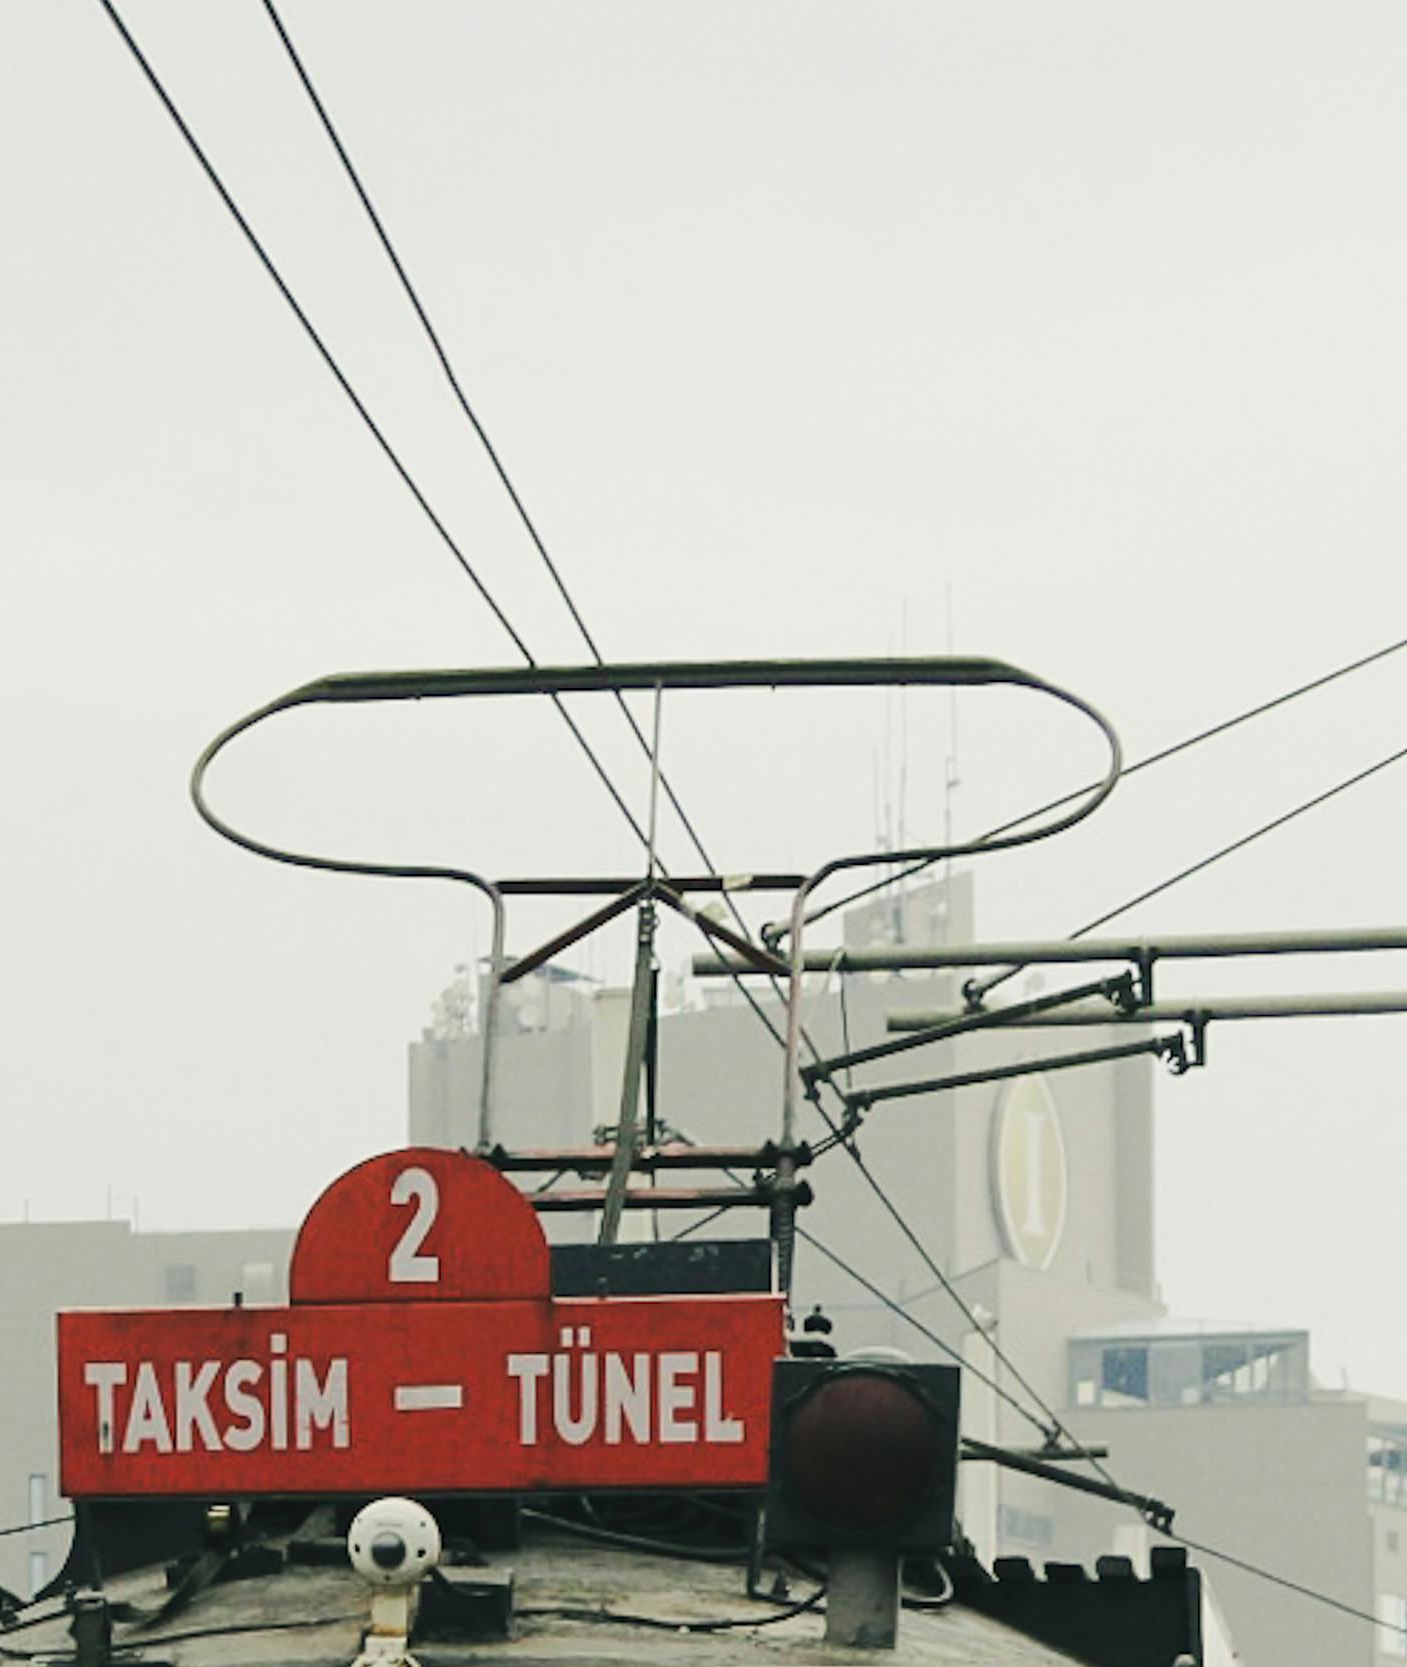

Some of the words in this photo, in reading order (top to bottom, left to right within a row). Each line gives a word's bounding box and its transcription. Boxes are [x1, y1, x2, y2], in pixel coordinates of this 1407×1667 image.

[389, 1167, 439, 1282] 2
[84, 1333, 350, 1453] TAKSİM
[507, 1326, 744, 1445] TÜNEL
